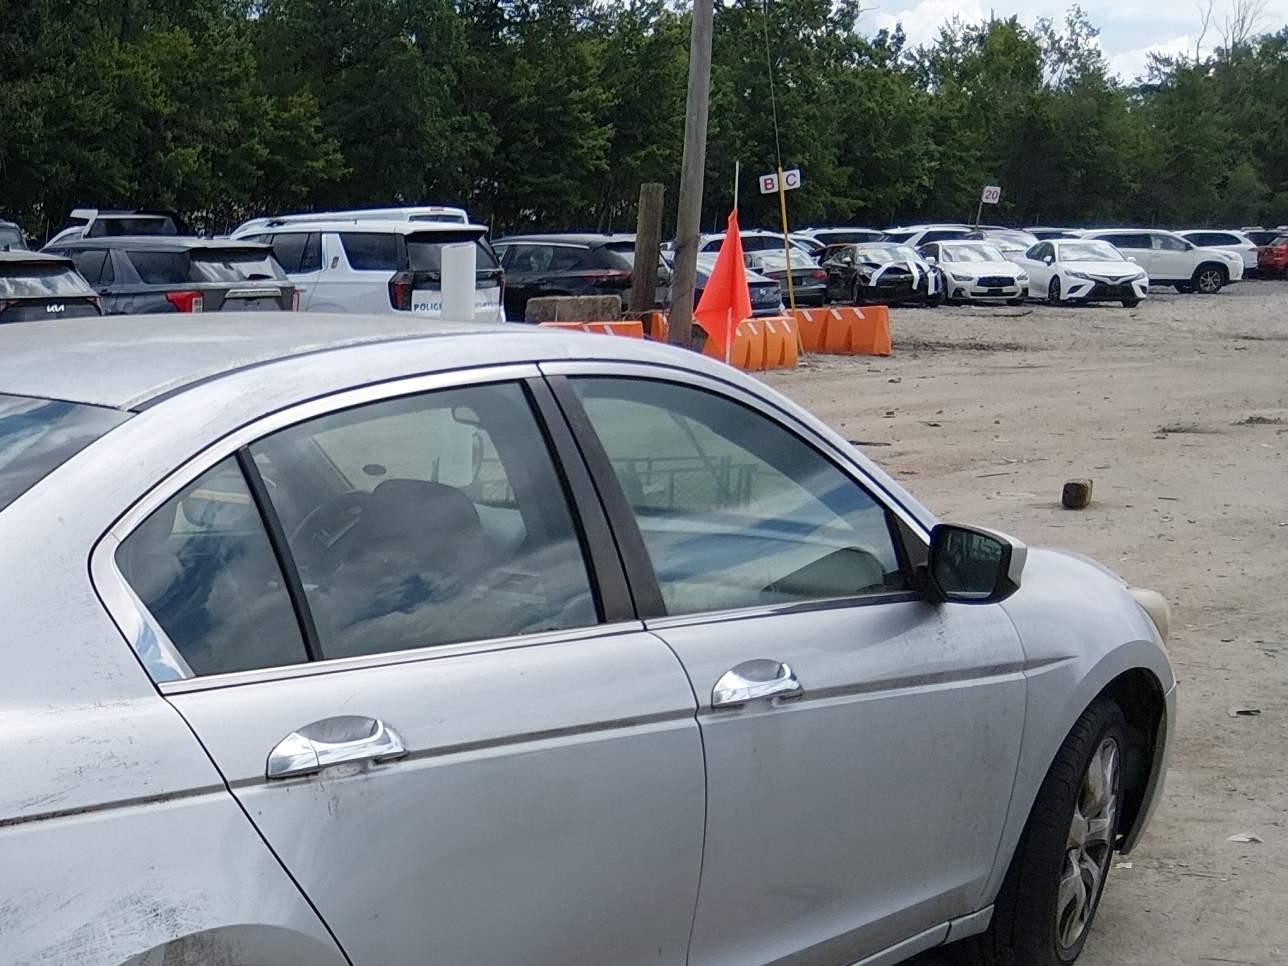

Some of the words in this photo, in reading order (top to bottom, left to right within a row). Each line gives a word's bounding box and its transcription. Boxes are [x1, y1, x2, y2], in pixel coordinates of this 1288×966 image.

[764, 178, 775, 190] B
[786, 173, 797, 187] C
[985, 190, 999, 200] 20
